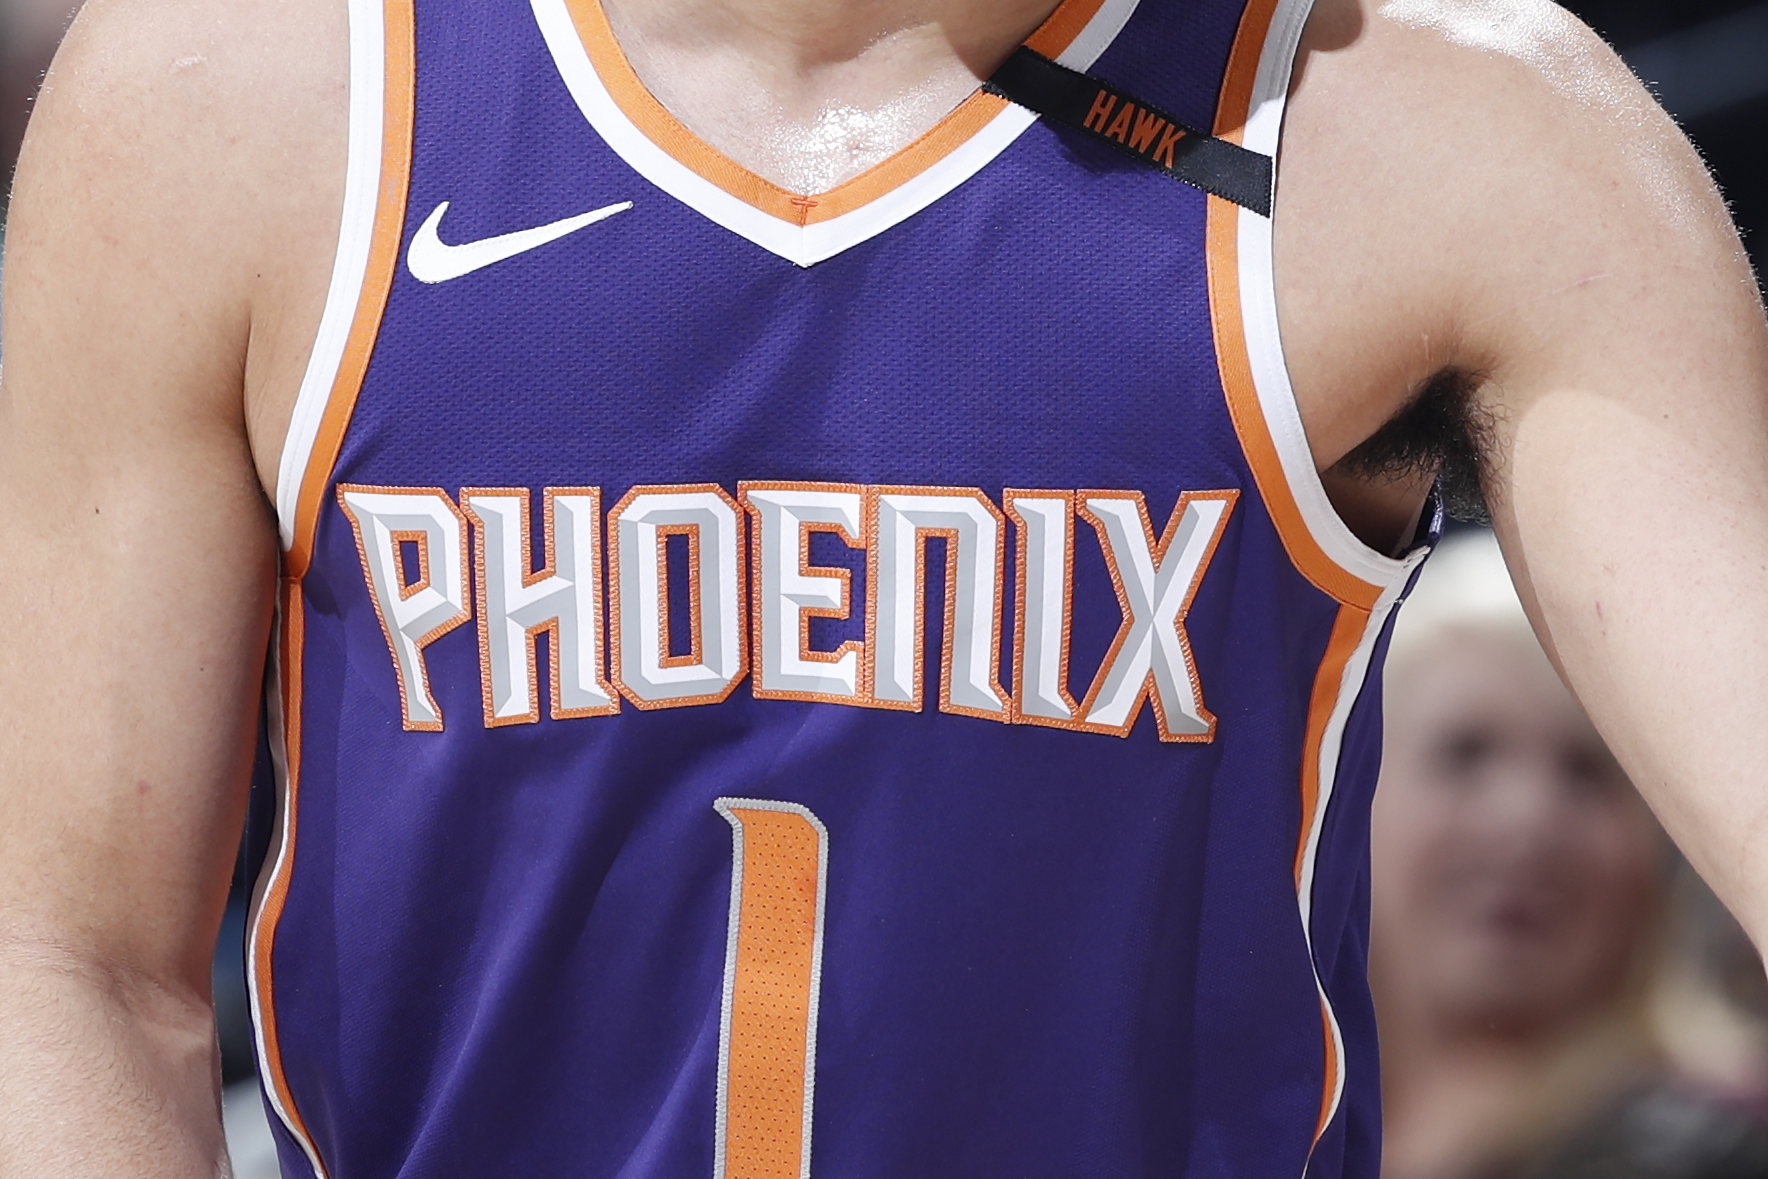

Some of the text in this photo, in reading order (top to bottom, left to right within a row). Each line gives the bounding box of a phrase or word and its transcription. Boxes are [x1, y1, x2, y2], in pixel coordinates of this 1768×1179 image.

[1082, 89, 1187, 169] HAWK
[337, 480, 1240, 744] PHOENIX
[712, 796, 829, 1179] 1
